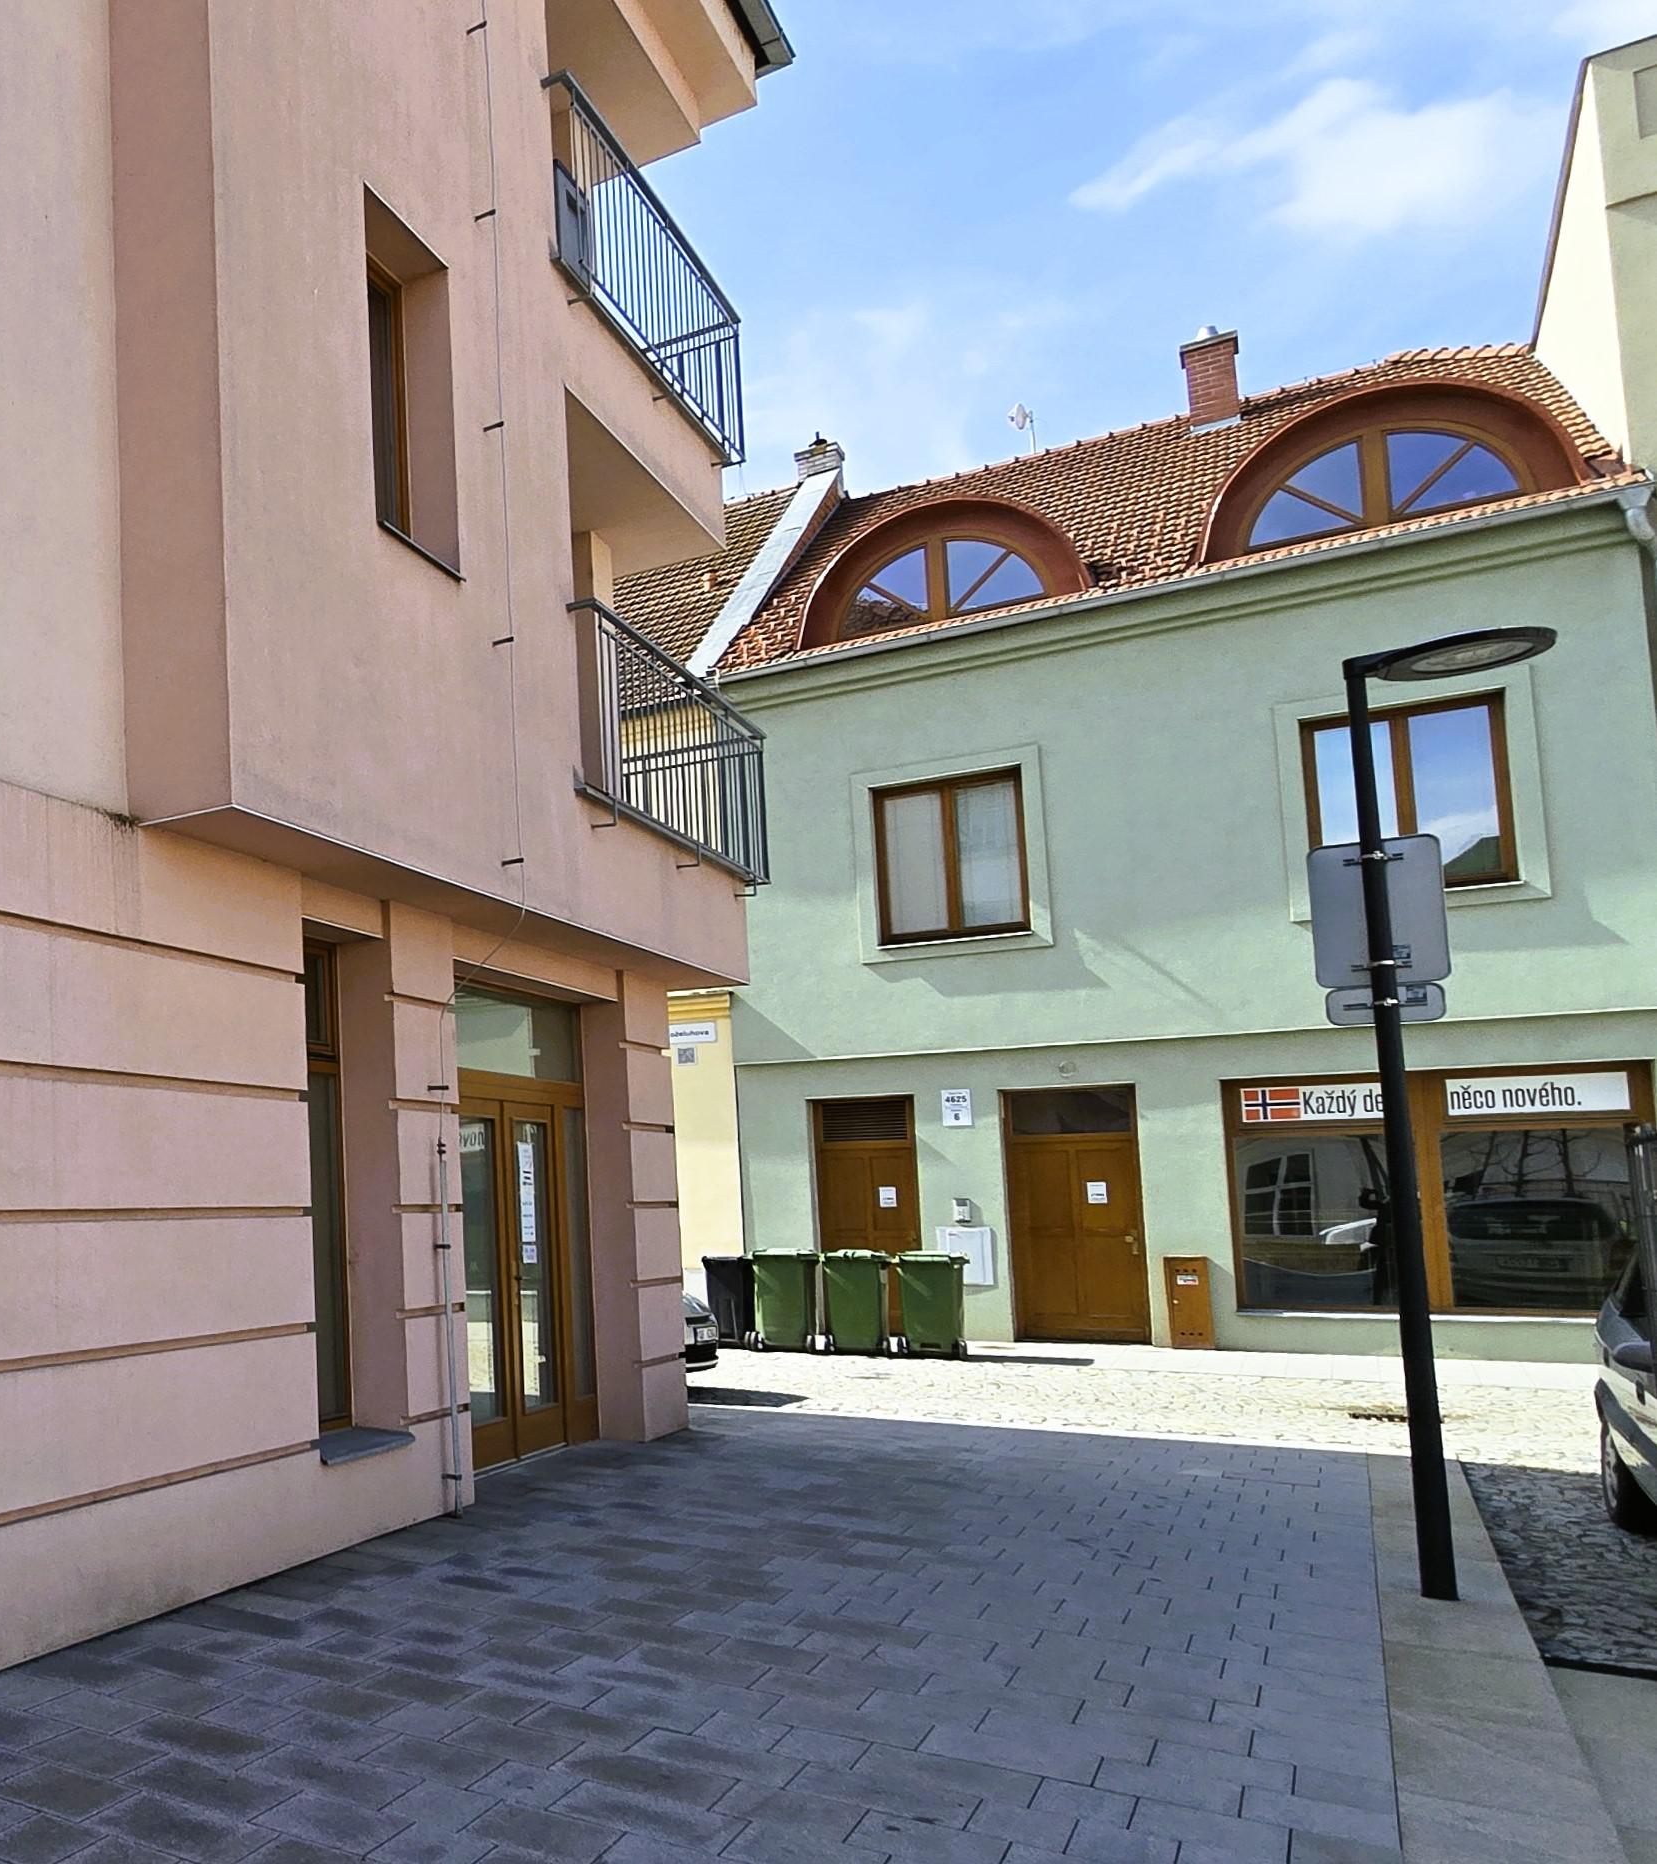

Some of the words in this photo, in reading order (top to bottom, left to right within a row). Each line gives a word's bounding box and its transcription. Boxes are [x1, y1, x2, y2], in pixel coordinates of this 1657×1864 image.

[670, 1030, 710, 1038] oželuhova
[1302, 1089, 1357, 1117] Každý
[1363, 1090, 1384, 1113] de
[1450, 1085, 1495, 1110] něco
[1502, 1081, 1582, 1108] nového.
